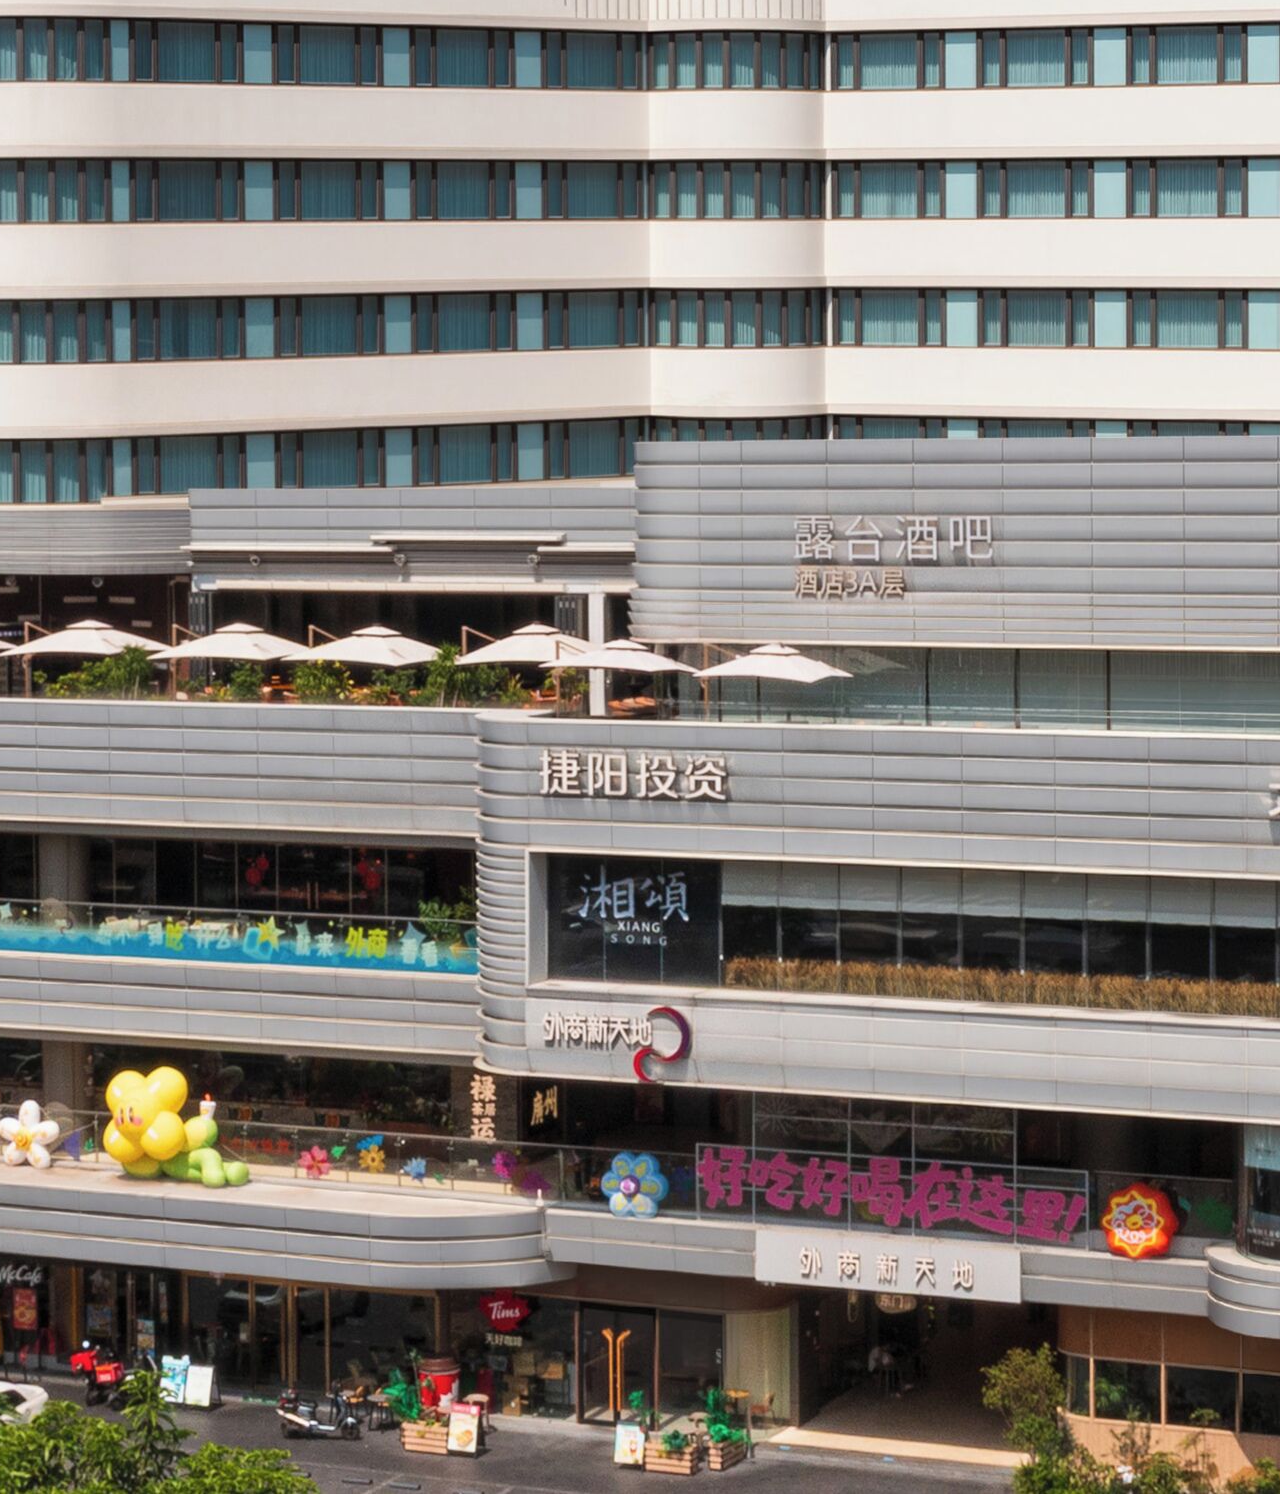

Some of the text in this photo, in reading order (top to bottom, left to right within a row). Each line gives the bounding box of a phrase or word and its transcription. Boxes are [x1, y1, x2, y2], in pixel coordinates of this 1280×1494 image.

[792, 514, 995, 562] 露台酒吧
[793, 566, 907, 598] 酒店3A层
[538, 748, 729, 801] 捷阳投资
[577, 863, 690, 923] 湘頌
[610, 934, 669, 947] SONG
[617, 921, 662, 933] XIANG
[543, 1012, 653, 1046] 外商新天地
[697, 1145, 1089, 1244] 好吃好喝在这里!
[798, 1245, 976, 1292] 外商新天地
[488, 1300, 521, 1320] Tims
